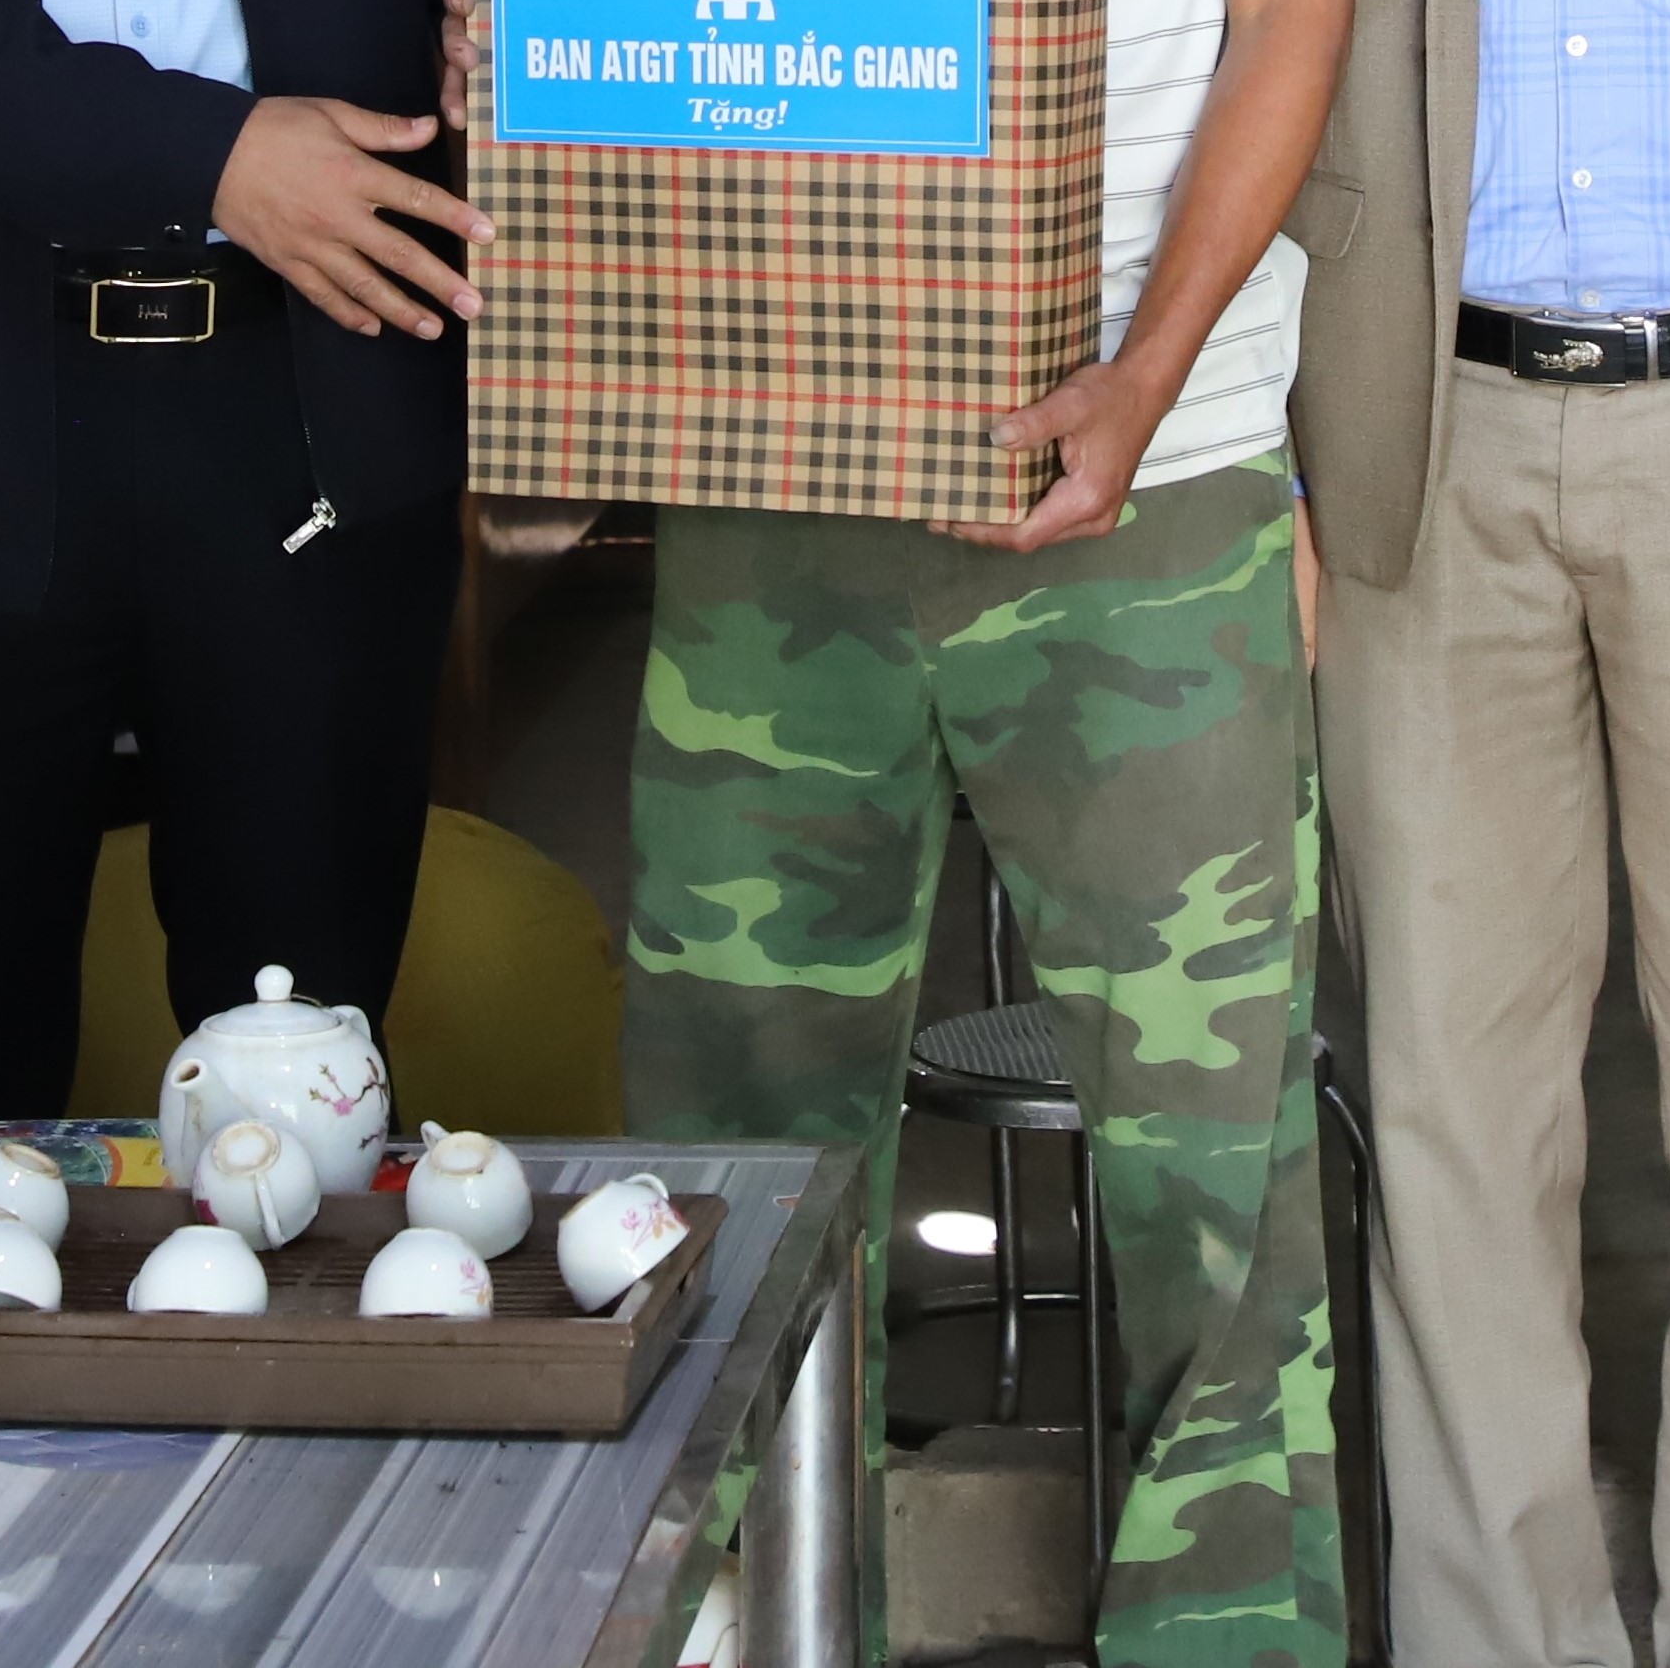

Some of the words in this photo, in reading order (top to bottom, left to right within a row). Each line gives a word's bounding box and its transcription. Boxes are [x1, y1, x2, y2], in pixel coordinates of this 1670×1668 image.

[527, 38, 592, 80] BAN
[601, 40, 679, 83] ATGT
[687, 27, 764, 85] TỈNH
[775, 30, 842, 88] BẮC
[854, 44, 958, 90] GIANG
[687, 98, 789, 131] Tặng!
